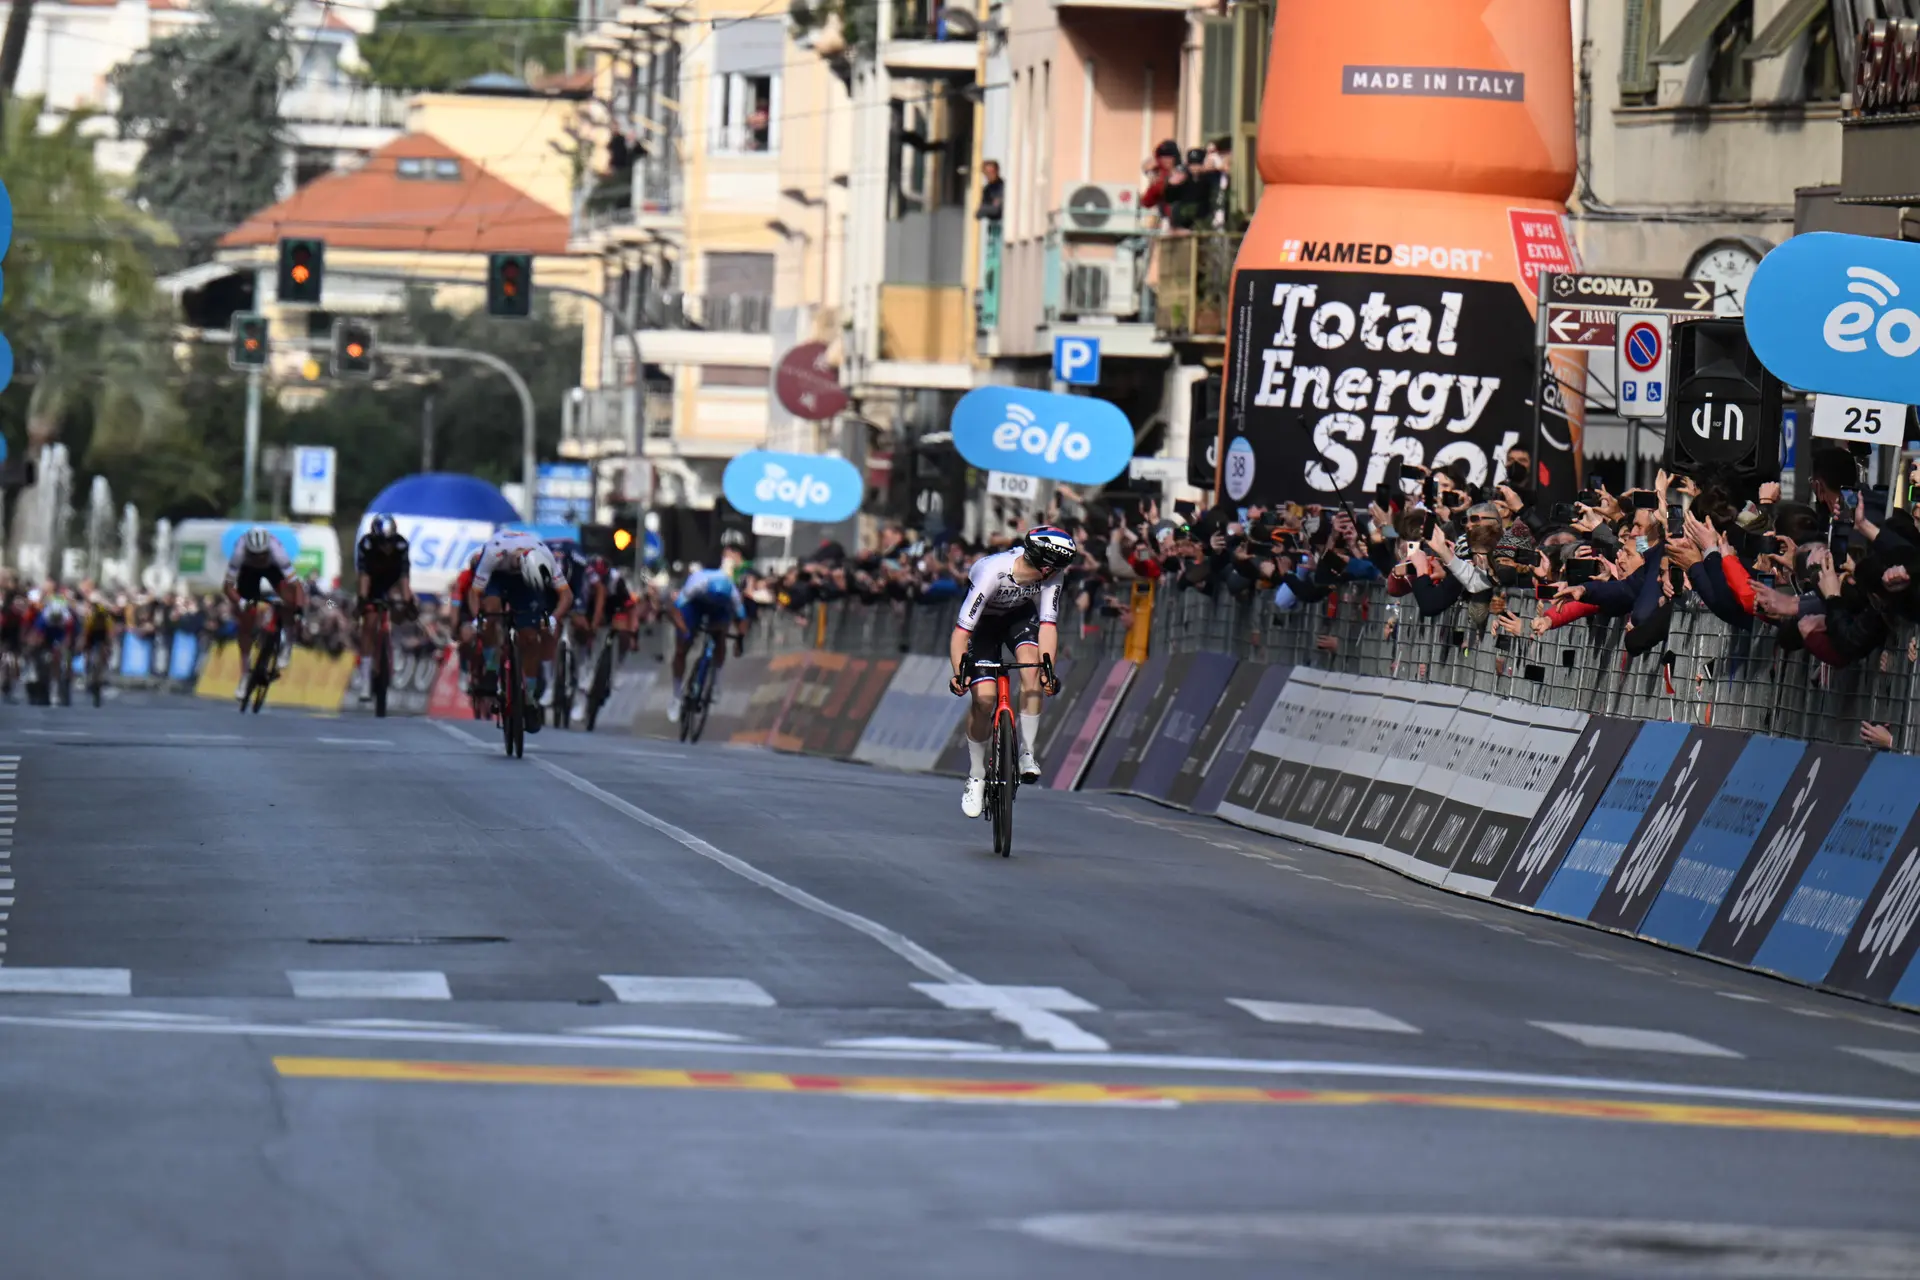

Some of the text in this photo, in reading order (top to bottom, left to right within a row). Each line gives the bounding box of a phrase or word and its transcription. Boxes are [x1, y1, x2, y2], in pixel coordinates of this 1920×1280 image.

[1352, 71, 1516, 95] MADE IN ITALY
[1526, 243, 1565, 261] EXTRA
[1577, 275, 1655, 297] CONAD
[1629, 297, 1659, 310] CITY
[1272, 283, 1464, 356] Total
[1060, 339, 1092, 380] P
[1253, 349, 1501, 434] Energy
[1625, 383, 1635, 399] P
[1843, 407, 1882, 435] 25
[991, 420, 1092, 464] eolo
[754, 473, 833, 509] eolo
[999, 474, 1029, 493] 100
[1044, 541, 1074, 558] RUDY
